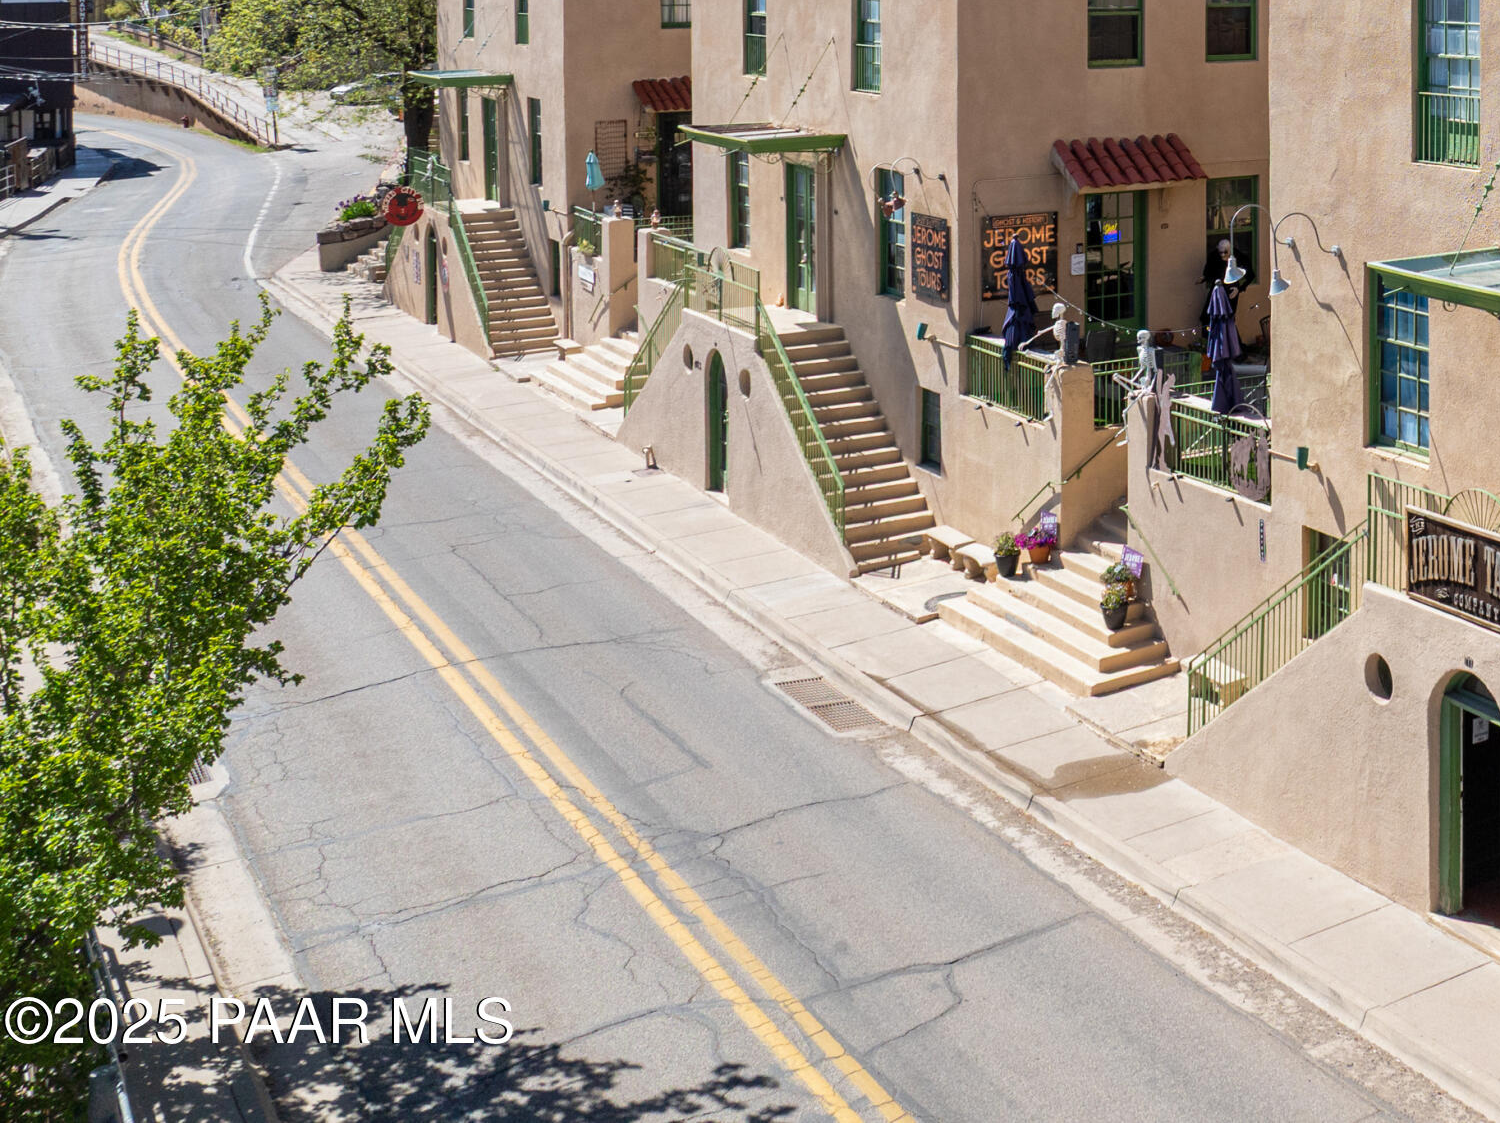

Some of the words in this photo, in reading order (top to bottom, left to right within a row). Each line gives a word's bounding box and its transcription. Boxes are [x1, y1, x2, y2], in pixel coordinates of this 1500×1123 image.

[912, 225, 947, 250] JEROME
[984, 225, 1055, 248] JEROME
[914, 247, 944, 270] GHOST
[916, 268, 942, 292] TOURS
[994, 268, 1046, 290] TORS
[1410, 534, 1475, 587] JEROME
[1453, 593, 1499, 621] COMPANY
